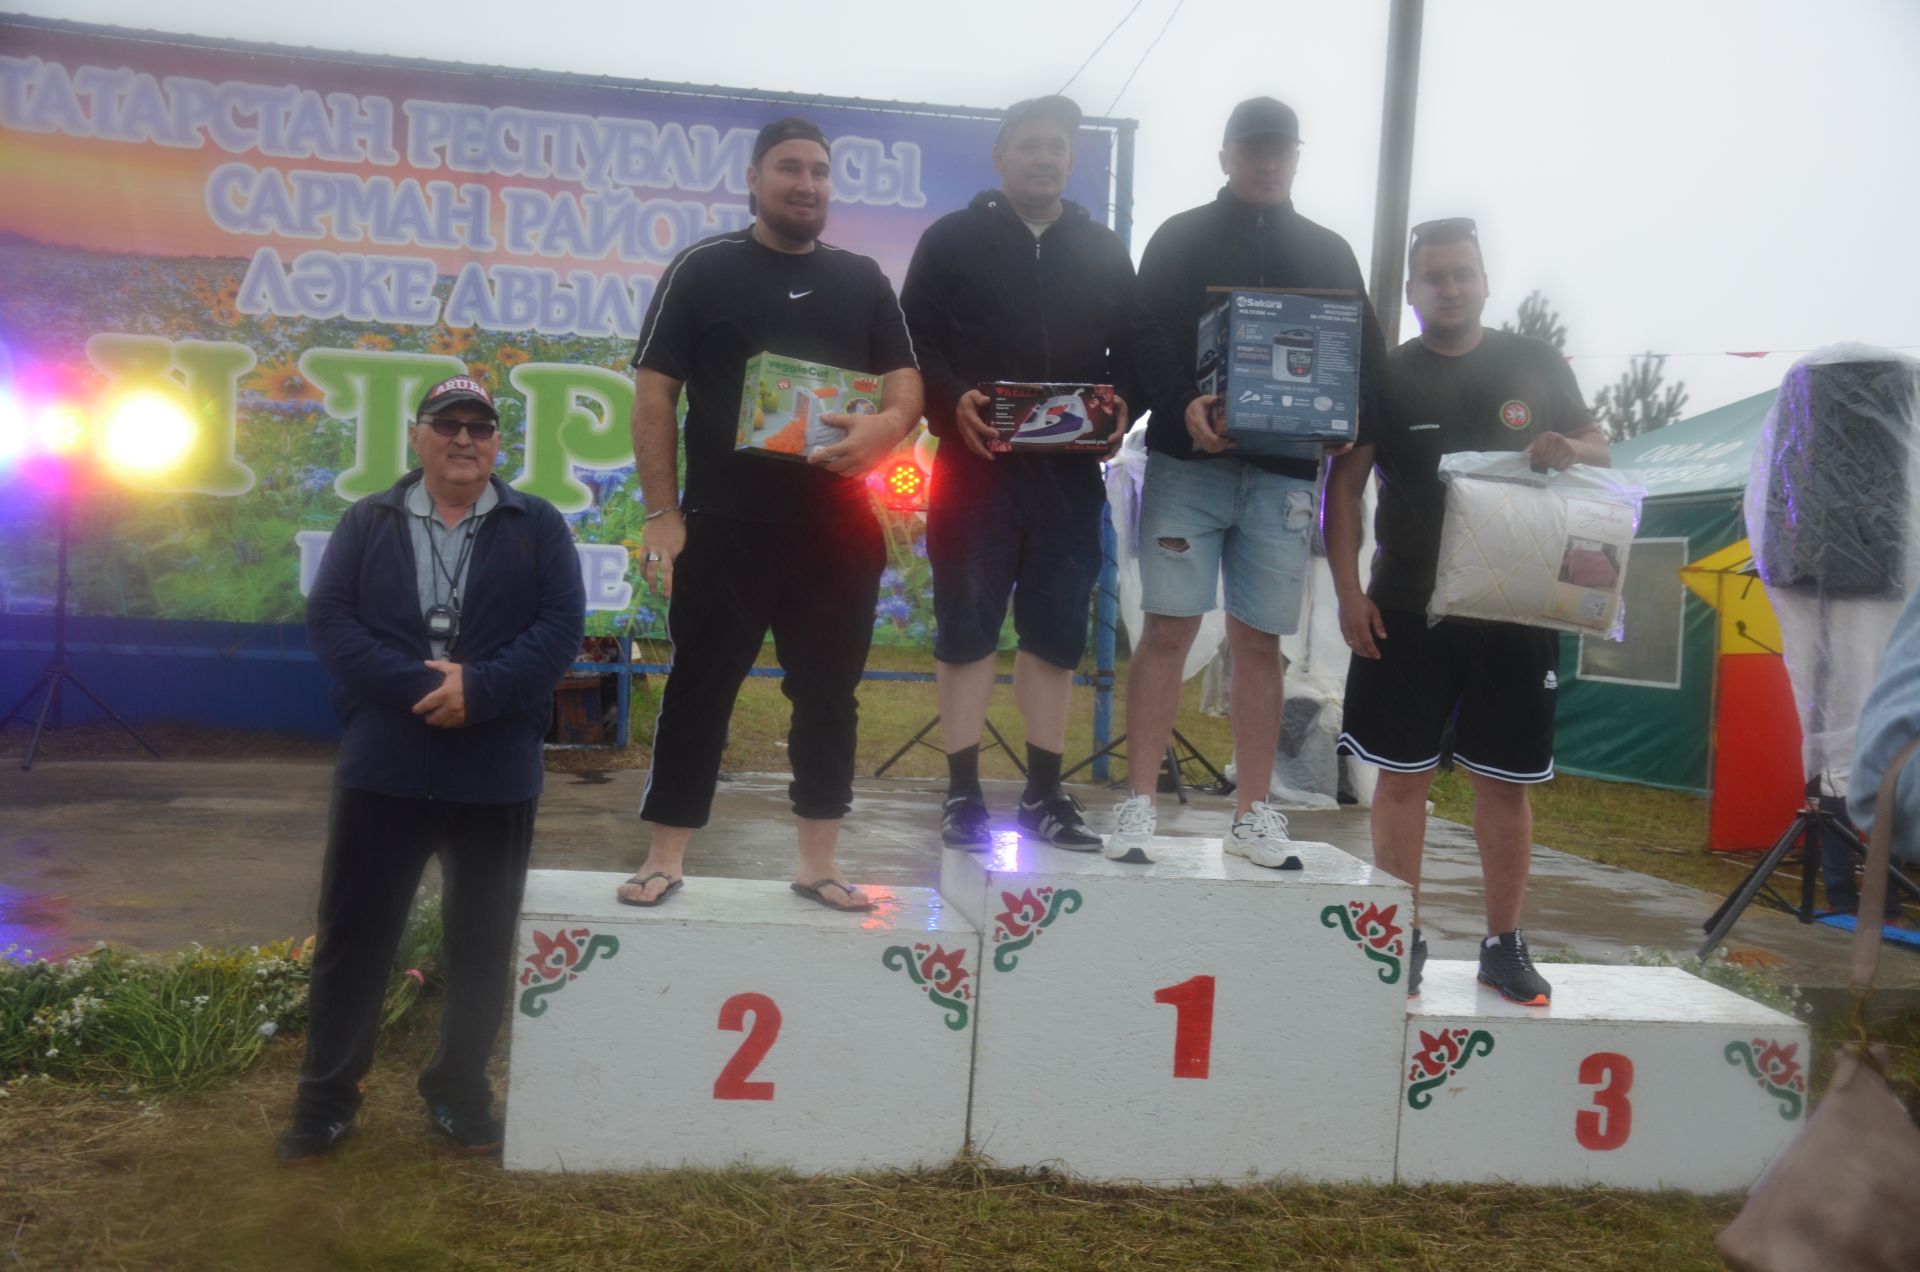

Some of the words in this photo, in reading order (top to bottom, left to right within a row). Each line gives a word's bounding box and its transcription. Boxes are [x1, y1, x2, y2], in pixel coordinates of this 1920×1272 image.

[0, 56, 399, 166] ТАТАРСТАН
[403, 100, 926, 208] РЕСПУБЛИСЫ
[206, 162, 496, 252] САРМАН
[502, 186, 758, 268] РАЙОН
[236, 247, 441, 326] ЛӘКЕ
[444, 262, 666, 340] АВЫЛ
[713, 993, 782, 1100] 2
[1154, 975, 1216, 1079] 1
[1575, 1051, 1634, 1151] 3
